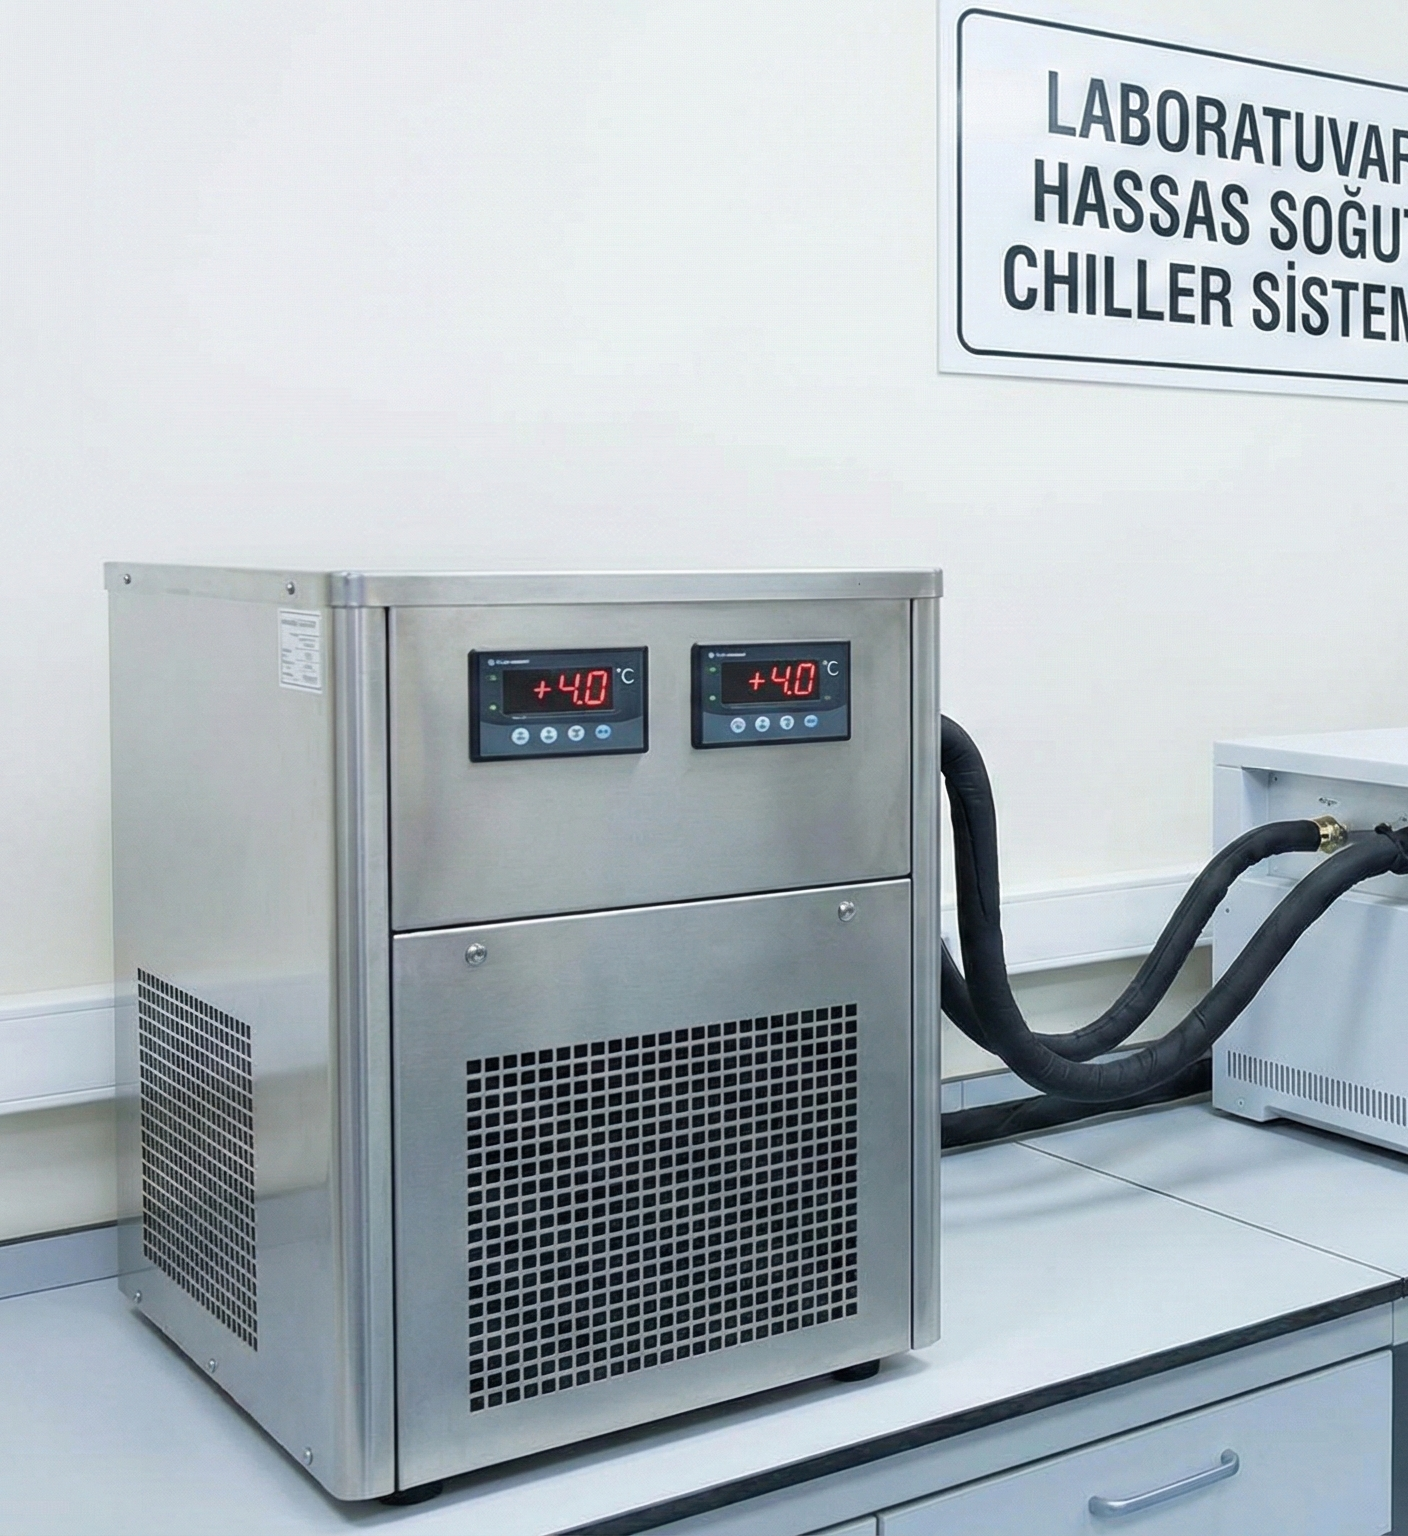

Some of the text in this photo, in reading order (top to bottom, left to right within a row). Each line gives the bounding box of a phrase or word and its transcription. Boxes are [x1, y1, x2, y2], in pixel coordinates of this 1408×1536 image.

[1034, 158, 1250, 246] HASSAS
[1003, 244, 1233, 329] CHILLER
[533, 670, 608, 705] +4.0
[748, 662, 816, 695] +4.0
